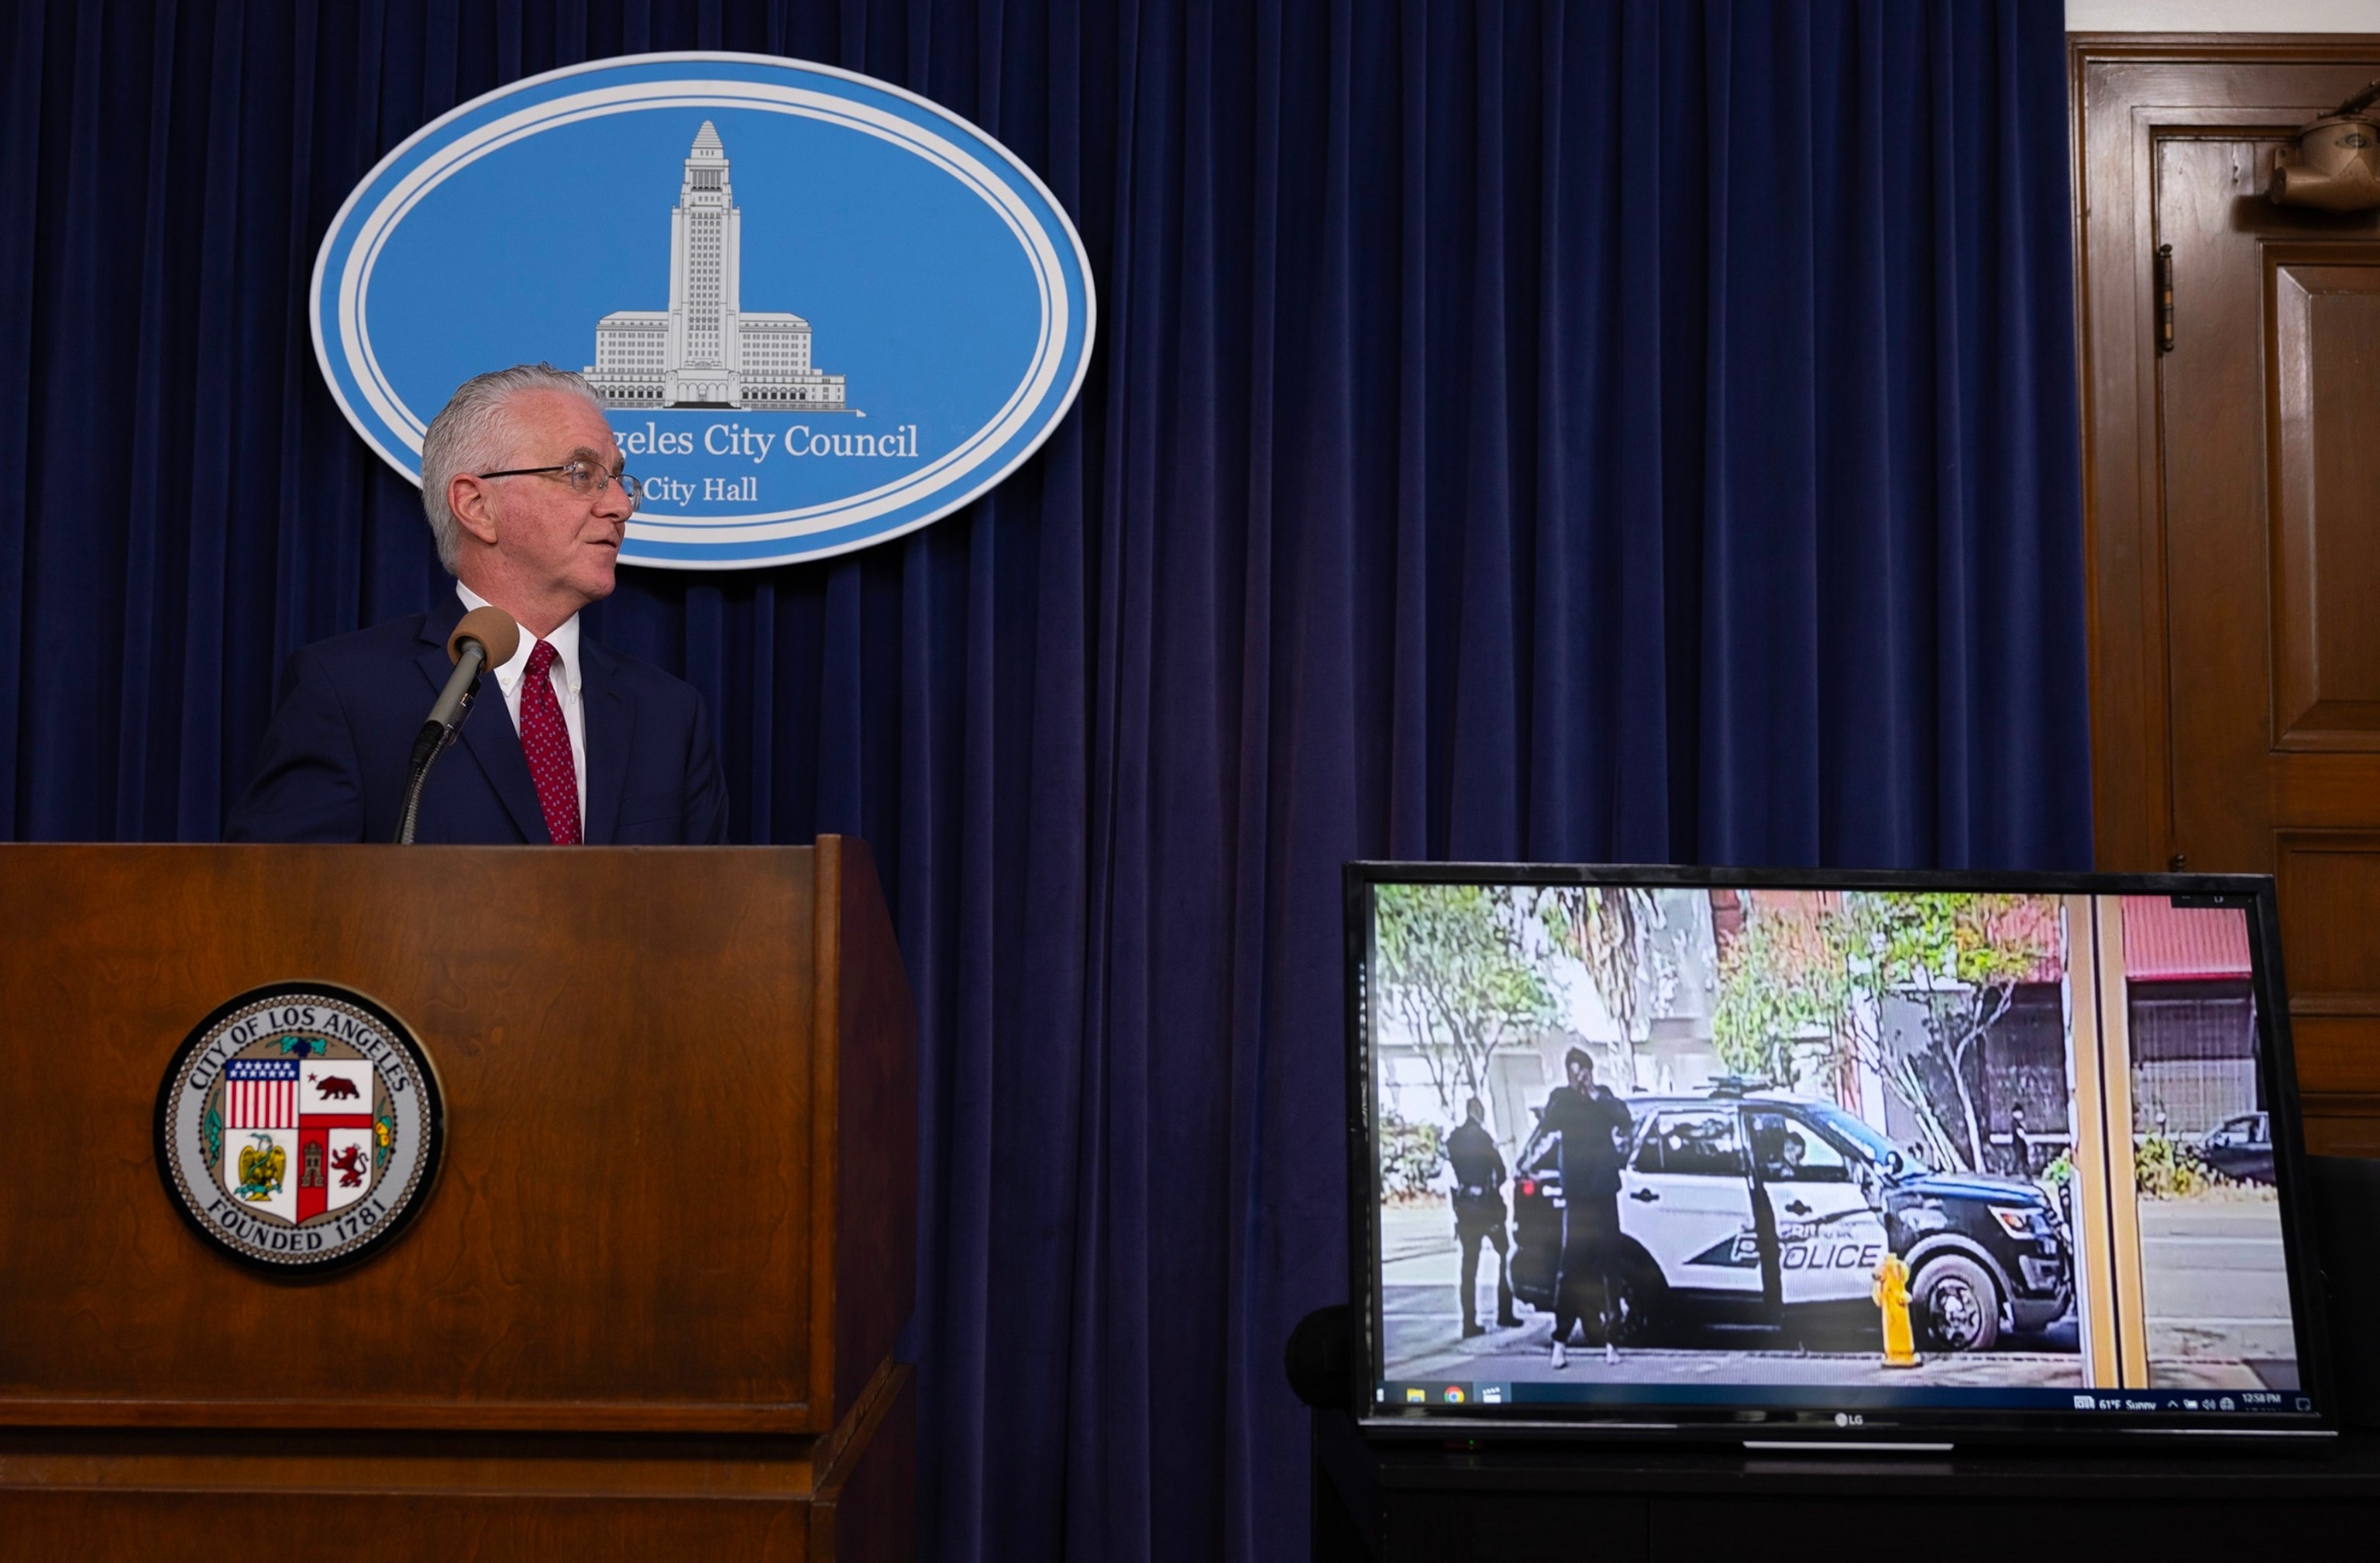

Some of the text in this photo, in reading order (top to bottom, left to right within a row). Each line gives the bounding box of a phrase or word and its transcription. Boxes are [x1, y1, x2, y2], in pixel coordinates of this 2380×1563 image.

[703, 423, 776, 463] City
[785, 425, 919, 457] Council
[643, 477, 758, 507] City Hall
[190, 1007, 410, 1092] CITY OF LOS ANGELES
[208, 1198, 386, 1251] FOUNDED 1781
[1849, 1414, 1863, 1425] LG
[2125, 1399, 2157, 1410] Sunny
